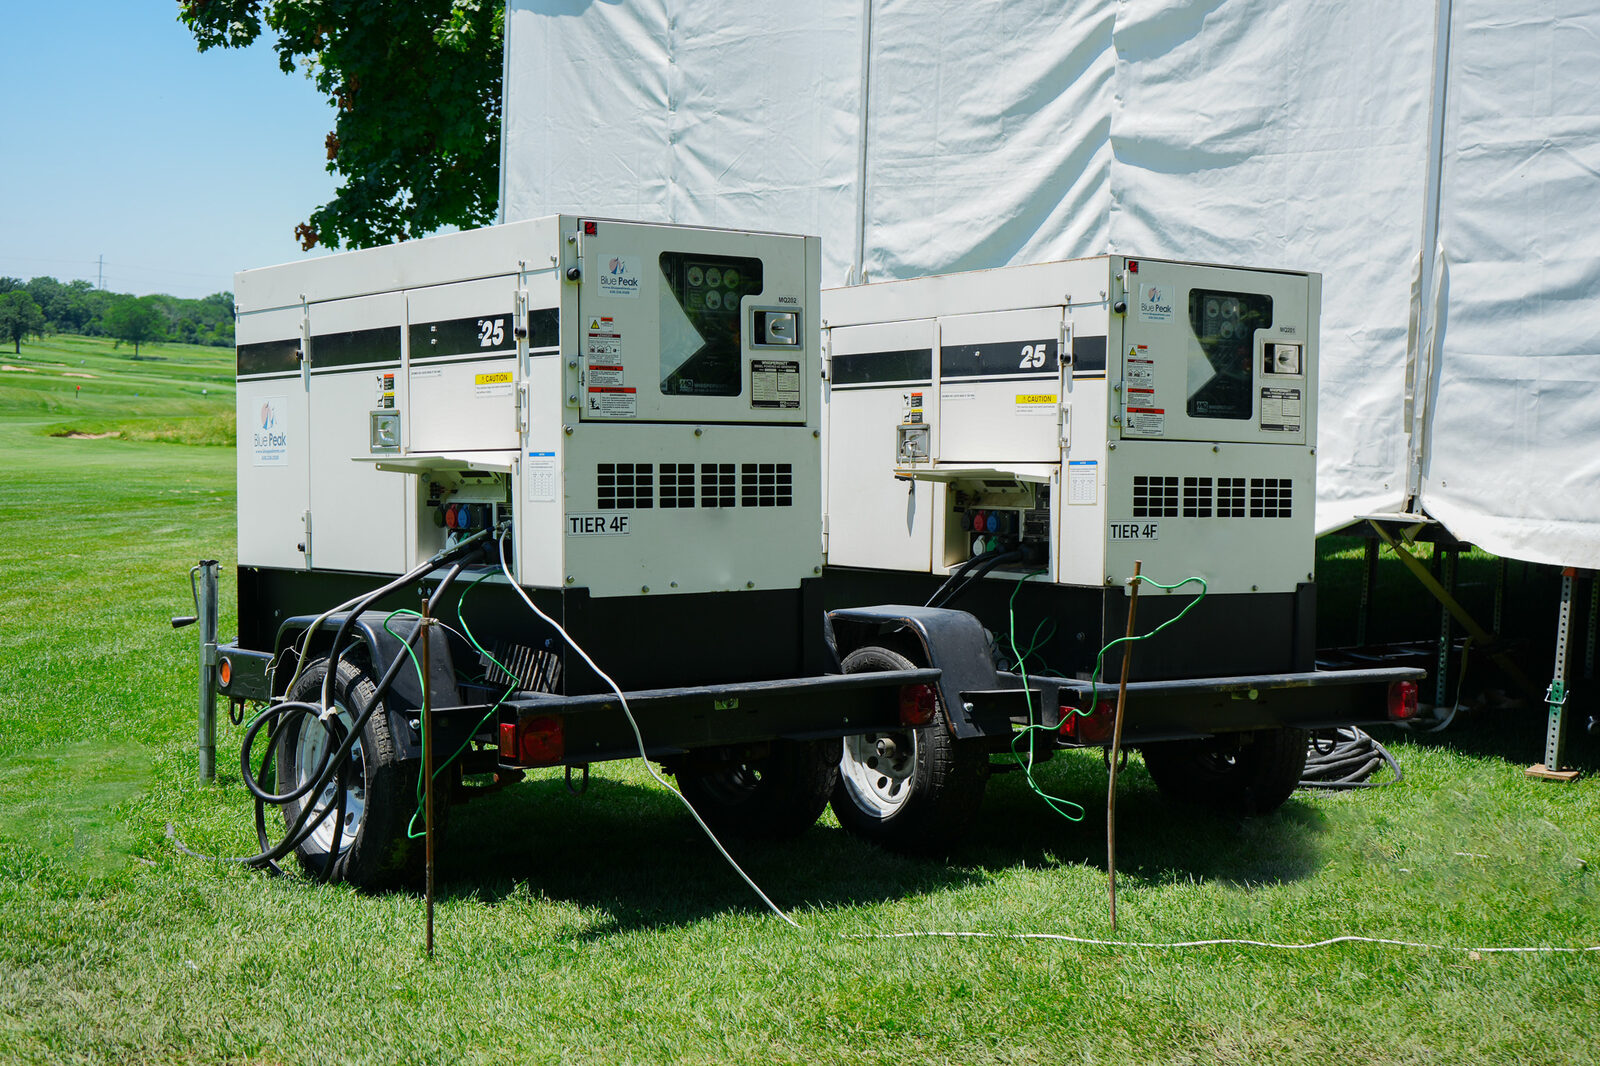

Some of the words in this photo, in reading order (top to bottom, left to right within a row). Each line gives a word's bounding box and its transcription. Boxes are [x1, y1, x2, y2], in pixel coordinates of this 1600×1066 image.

[600, 276, 617, 286] Blue
[618, 277, 638, 287] Peak
[1141, 302, 1154, 312] Blue
[1155, 303, 1171, 313] Peak
[479, 319, 504, 347] 25
[1019, 344, 1046, 368] 25
[485, 374, 508, 383] CAUTION
[1027, 395, 1052, 403] CAUTION
[254, 432, 268, 448] Blue
[268, 431, 286, 446] Peak
[569, 517, 605, 533] TIER
[610, 517, 628, 533] 4F
[1110, 524, 1139, 539] TIER
[1142, 524, 1157, 538] 4F
